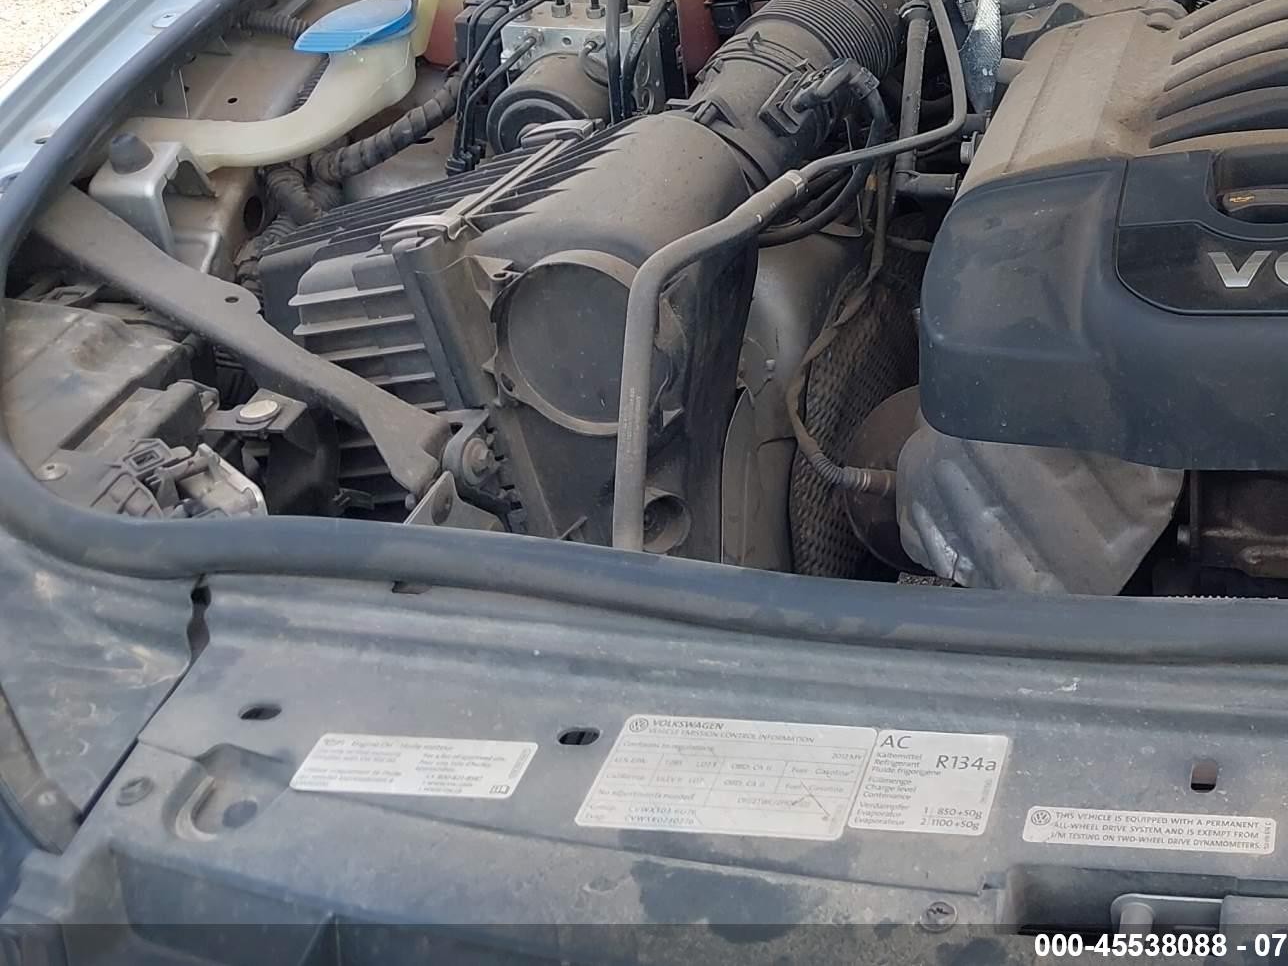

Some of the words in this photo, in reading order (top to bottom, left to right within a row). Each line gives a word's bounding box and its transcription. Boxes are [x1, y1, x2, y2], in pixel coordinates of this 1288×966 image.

[652, 720, 724, 730] VOLKSWAGEN
[720, 731, 756, 739] CONTROL
[759, 733, 815, 743] INFORMATION
[880, 734, 912, 749] AC
[936, 754, 997, 772] R134a
[864, 784, 896, 793] Charge
[936, 807, 957, 816] 850
[931, 818, 954, 827] 1100
[1056, 811, 1074, 819] THIS
[1077, 813, 1111, 822] VEHICLE
[1115, 814, 1122, 822] IS
[1125, 815, 1168, 824] EQUIPPED
[1170, 817, 1194, 825] WITH
[1196, 818, 1203, 826] A
[1205, 819, 1260, 829] PERMANENT
[1054, 821, 1099, 831] ALL-WHEEL
[1102, 824, 1127, 832] DRIVE
[1130, 826, 1162, 835] SYSTEM
[1164, 827, 1184, 835] AND
[1187, 828, 1194, 836] IS
[1197, 829, 1232, 837] EXEMPT
[1234, 831, 1260, 839] FROM
[1068, 833, 1100, 841] TESTING
[1102, 834, 1115, 842] ON
[1117, 835, 1166, 844] TWO-WHEEL
[1167, 837, 1191, 846] DRIVE
